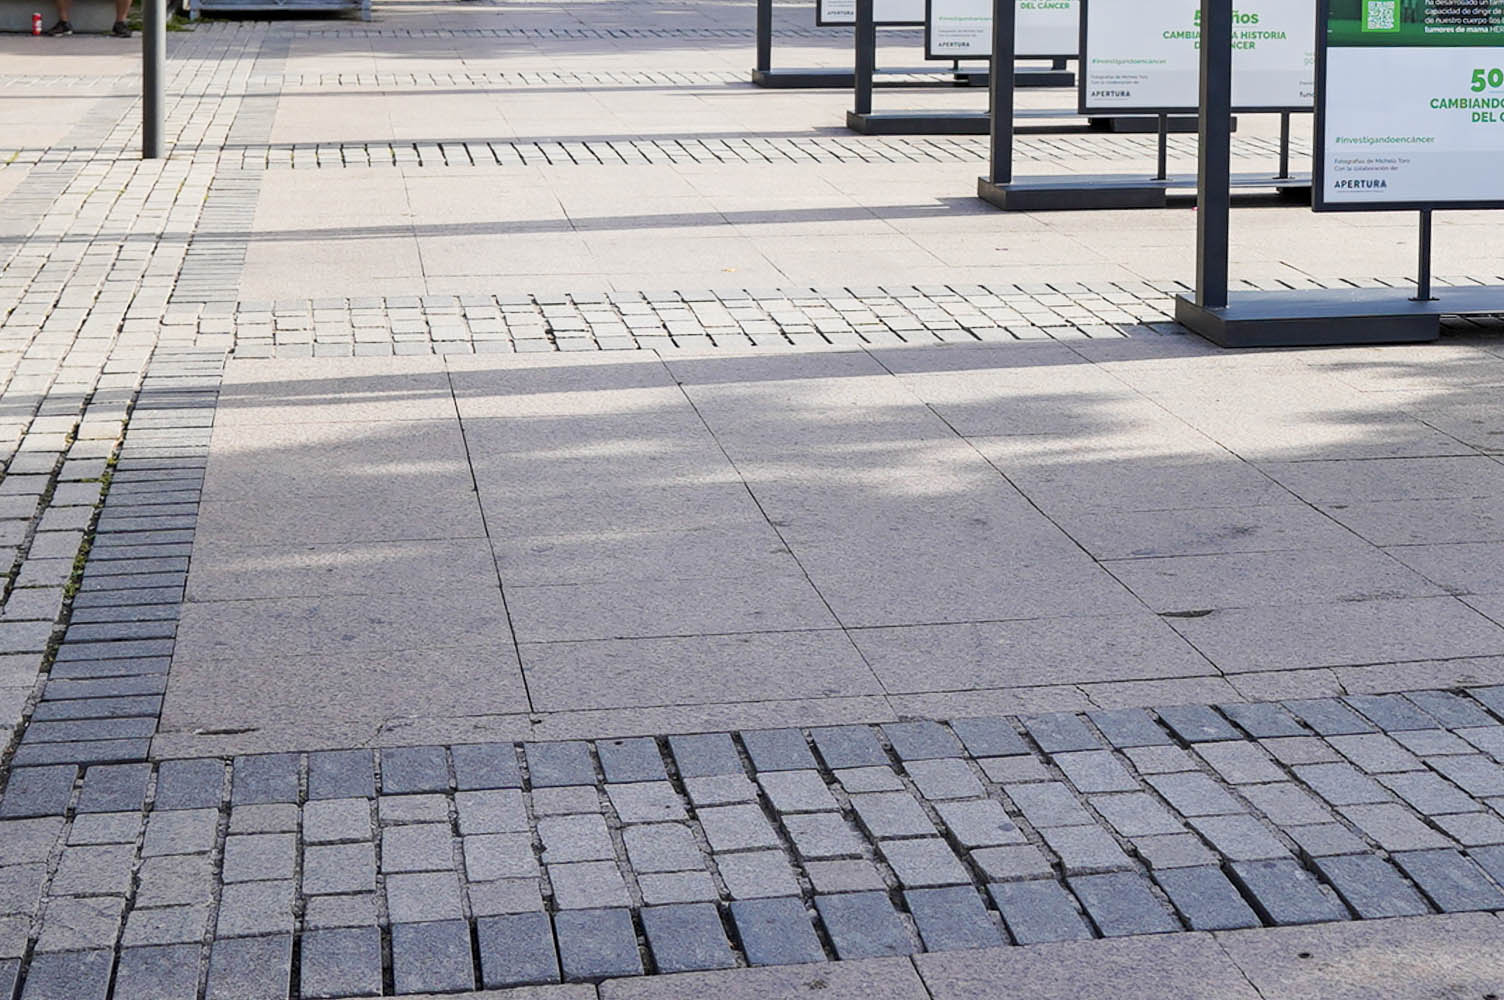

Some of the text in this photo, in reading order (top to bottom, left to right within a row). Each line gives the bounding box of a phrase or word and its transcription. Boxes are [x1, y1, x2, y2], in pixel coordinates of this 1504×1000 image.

[1163, 30, 1201, 41] CAMBIA
[1241, 31, 1288, 41] HISTORIA
[1231, 41, 1257, 51] NCER
[1091, 90, 1131, 98] APERTURA
[1471, 111, 1497, 123] DEL
[1334, 179, 1388, 189] APERTURA
